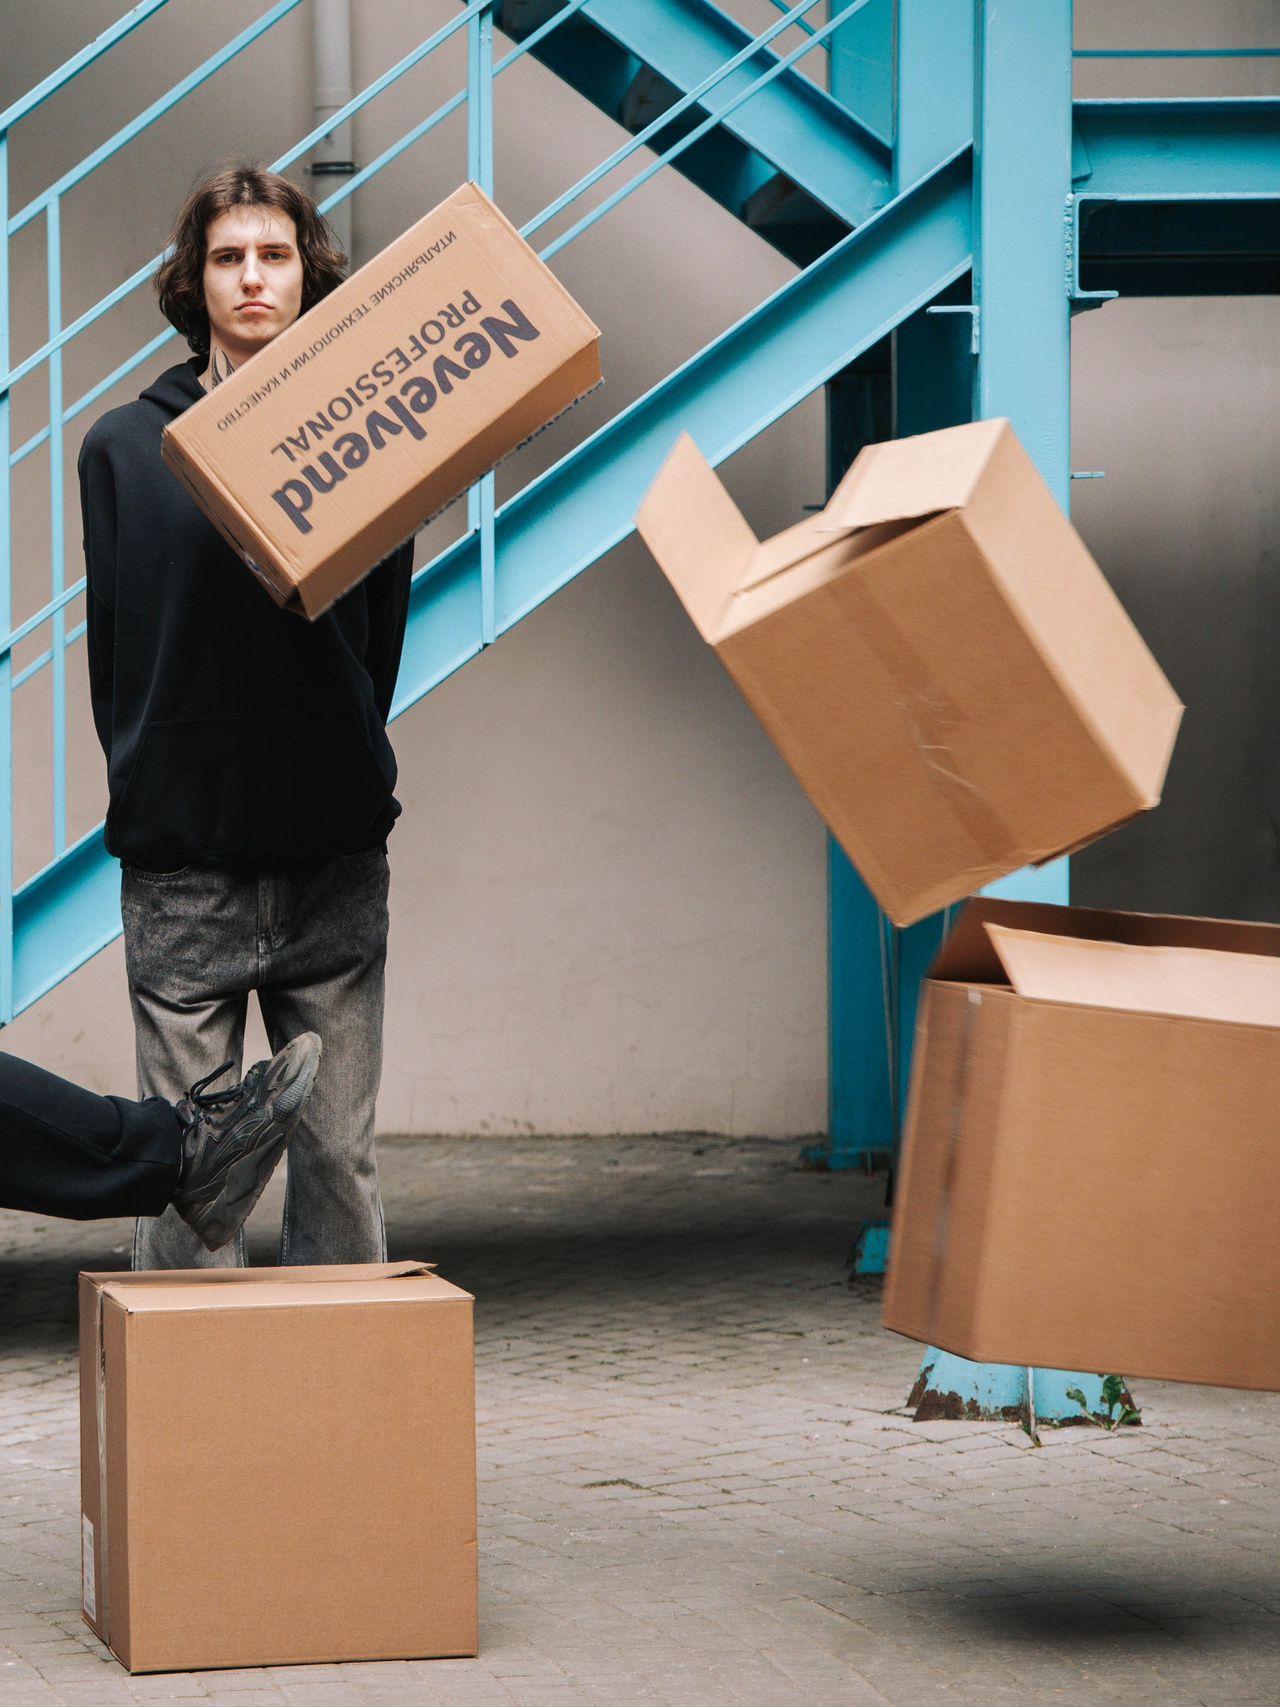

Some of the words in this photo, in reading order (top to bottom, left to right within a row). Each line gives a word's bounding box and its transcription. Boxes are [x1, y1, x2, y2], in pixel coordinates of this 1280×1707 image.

[370, 230, 457, 305] ИТАЛЬЯНСКИЕ
[290, 303, 371, 372] ТЕХНОЛОГИИ
[217, 376, 281, 431] КАЧЕСТВО
[270, 289, 483, 463] PROFESSIONAL
[279, 367, 293, 381] И
[270, 298, 541, 535] Nevelvend
